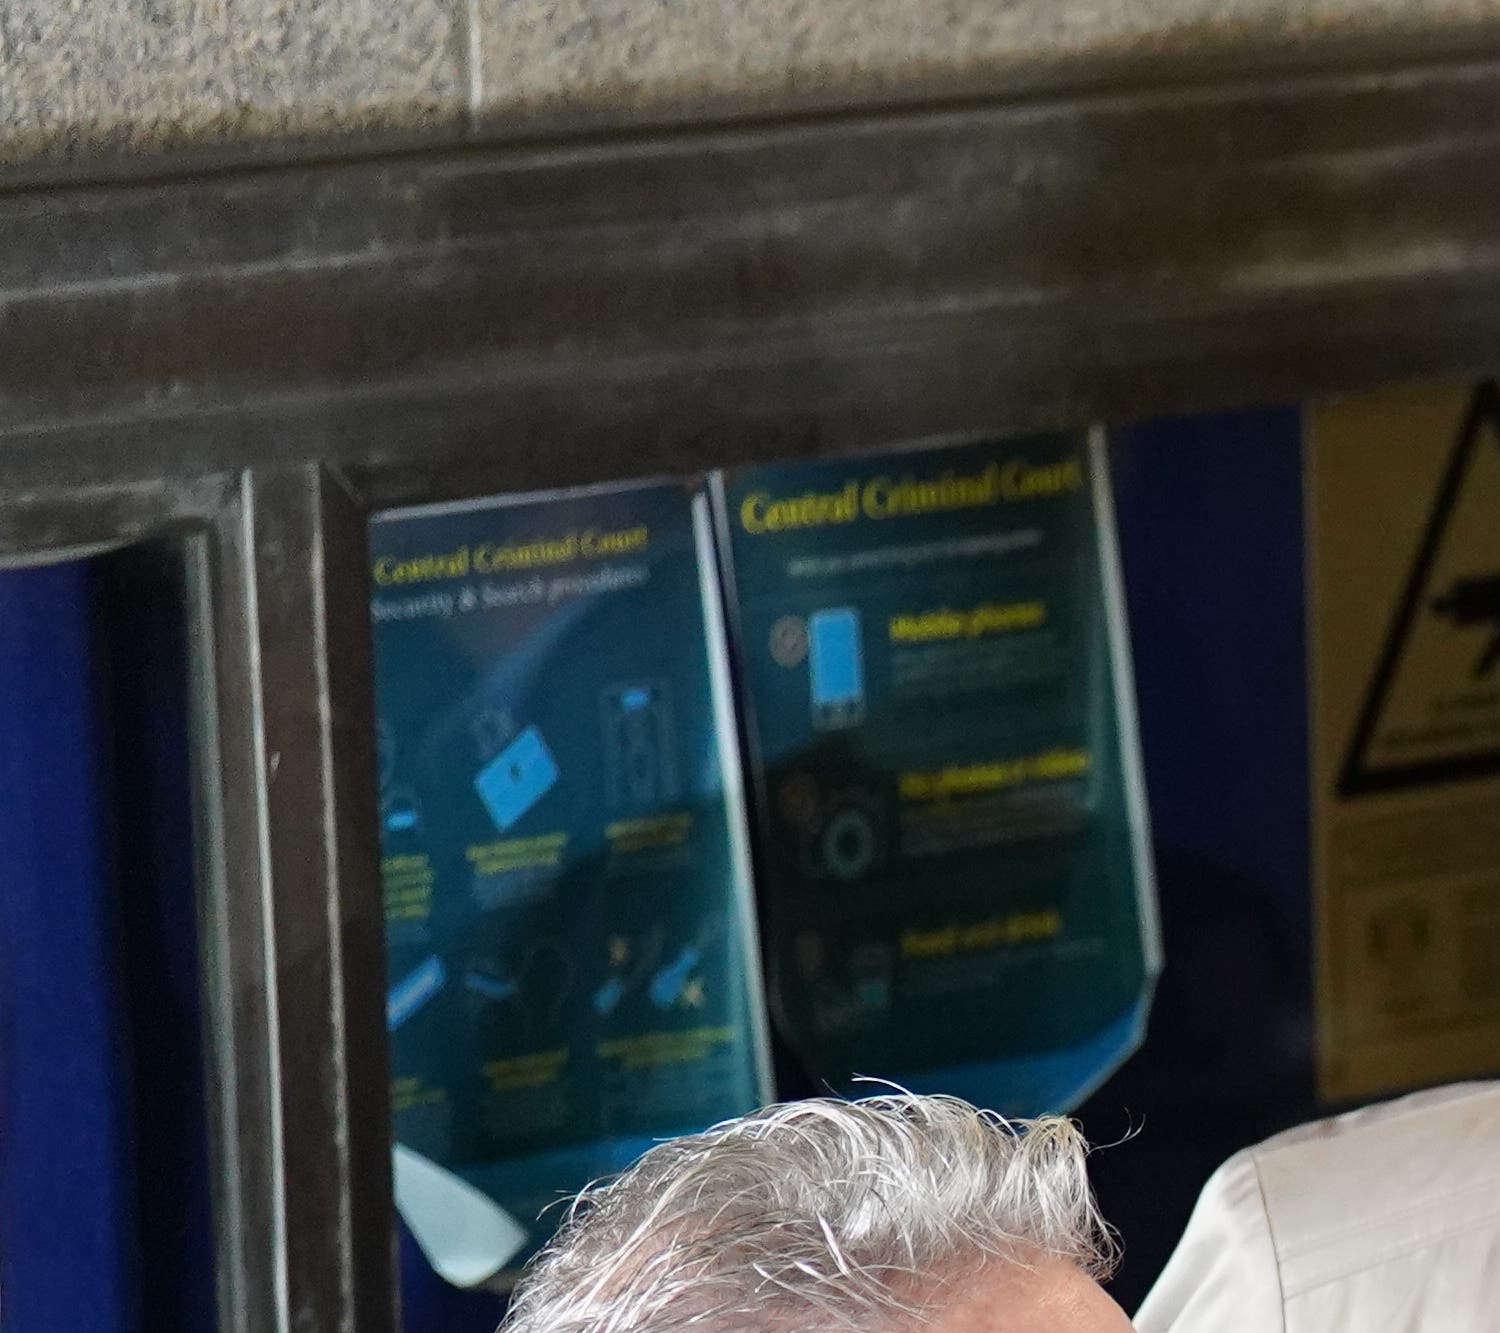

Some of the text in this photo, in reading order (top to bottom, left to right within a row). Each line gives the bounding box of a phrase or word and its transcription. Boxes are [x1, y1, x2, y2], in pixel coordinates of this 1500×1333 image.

[740, 460, 1084, 534] Central Criminal Court
[374, 526, 648, 584] Central Criminal Court
